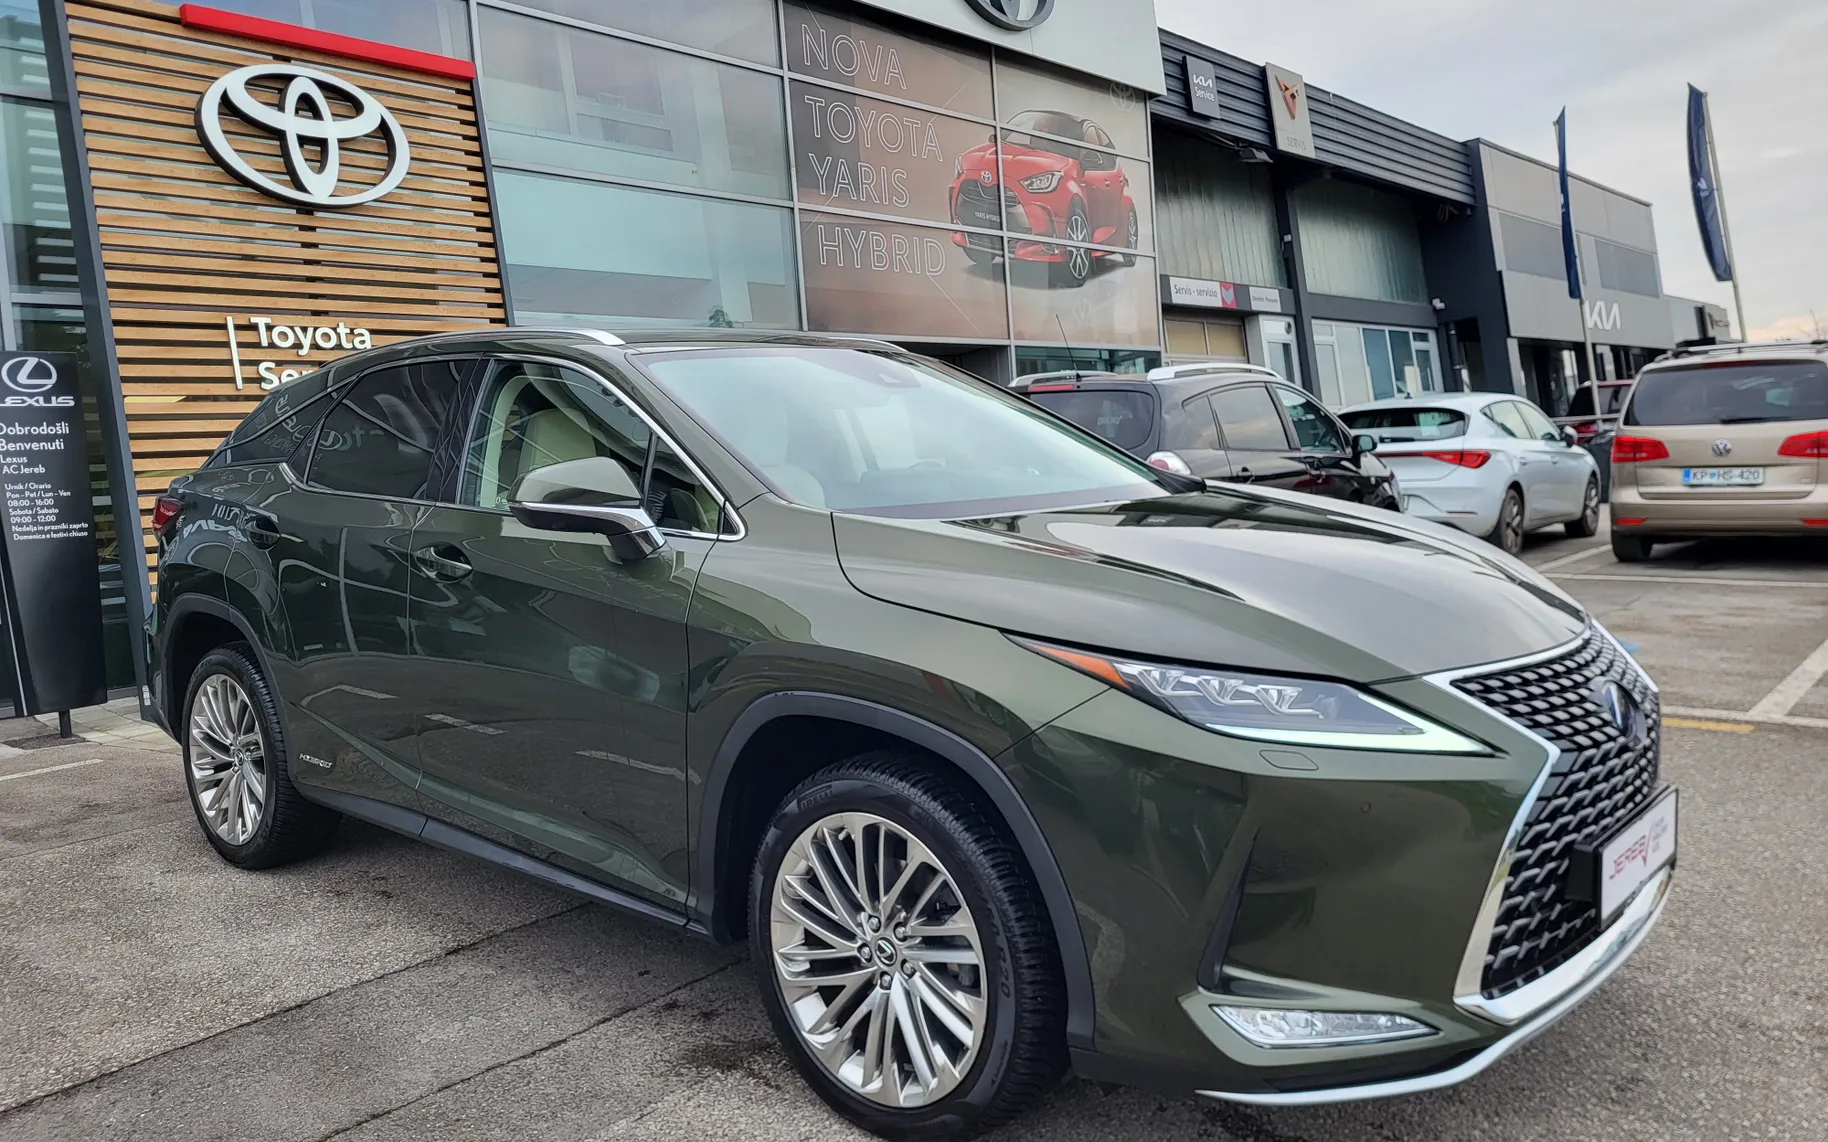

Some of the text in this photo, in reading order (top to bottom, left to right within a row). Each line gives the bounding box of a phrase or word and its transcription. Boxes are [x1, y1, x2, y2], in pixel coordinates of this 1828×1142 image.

[801, 23, 907, 90] NOVA
[1194, 87, 1215, 102] Service
[804, 95, 943, 162] TOYOTA
[808, 153, 910, 208] YARIS
[818, 225, 946, 276] HYBRID
[1174, 284, 1192, 296] Servis
[1196, 286, 1218, 298] servizio
[250, 316, 372, 356] Toyota
[0, 422, 69, 435] Dobrodošli
[0, 439, 64, 451] Benvenuti
[0, 454, 28, 464] Lexus
[2, 464, 45, 474] AC Jereb
[1692, 470, 1707, 479] KP
[28, 482, 52, 490] Orario
[6, 491, 20, 499] Pon
[25, 490, 37, 498] Pet
[58, 489, 71, 497] Ven
[7, 499, 30, 507] 08:00
[35, 498, 54, 506] 16:00
[9, 508, 32, 516] Sobota
[10, 516, 32, 524] 09:00
[37, 515, 56, 523] 12:00
[12, 524, 37, 533] Nedelja
[69, 522, 89, 530] zaprto
[13, 533, 46, 541] Domenica
[51, 531, 68, 539] festivi
[69, 530, 88, 538] chiuso
